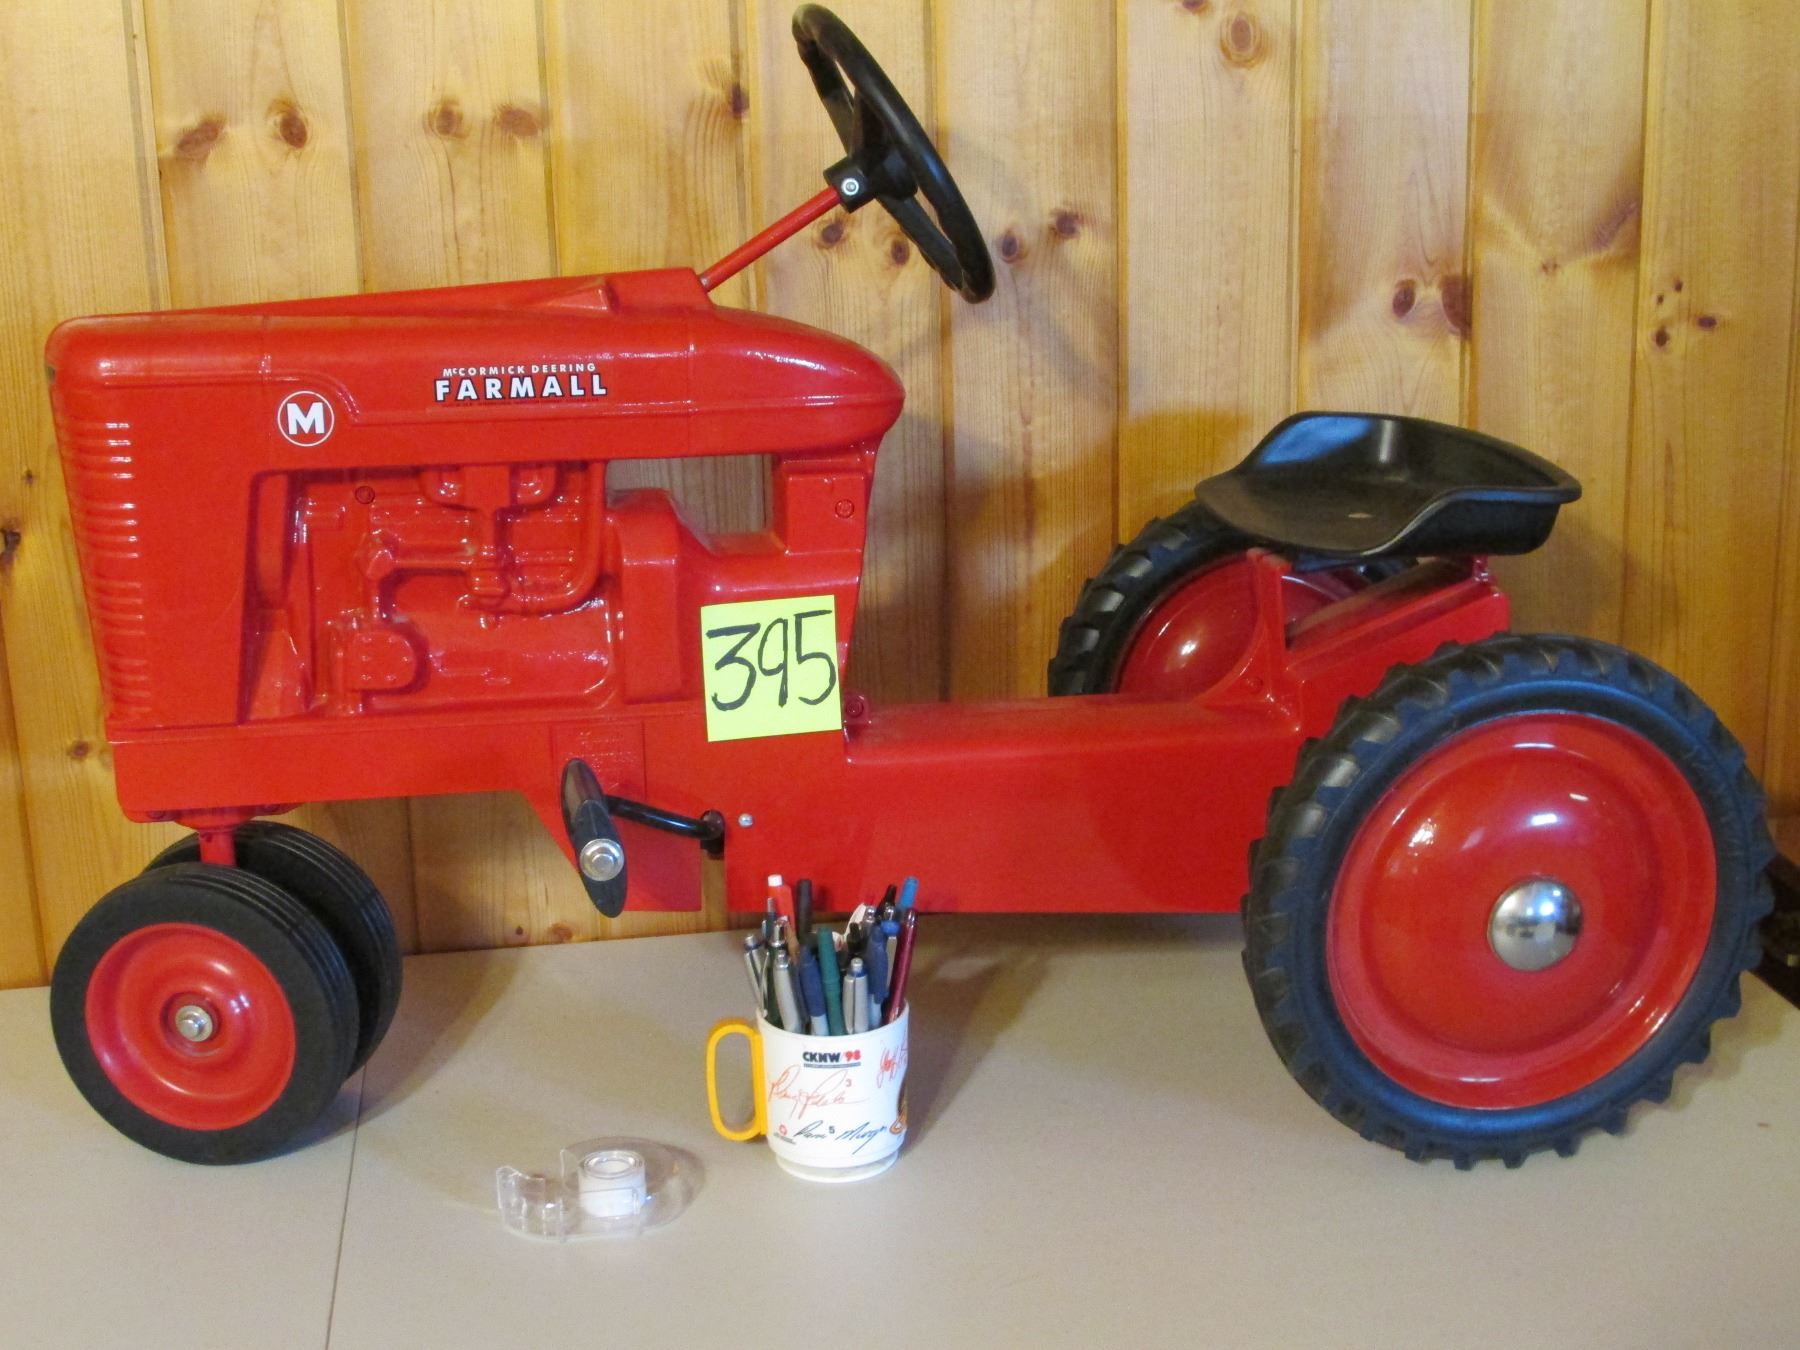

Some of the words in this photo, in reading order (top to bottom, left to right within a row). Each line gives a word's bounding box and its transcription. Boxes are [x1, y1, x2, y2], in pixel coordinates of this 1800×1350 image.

[531, 362, 596, 374] DEERING
[434, 373, 608, 402] FARMALL
[286, 402, 325, 436] M
[706, 609, 837, 711] 395
[802, 1051, 841, 1063] CKNW
